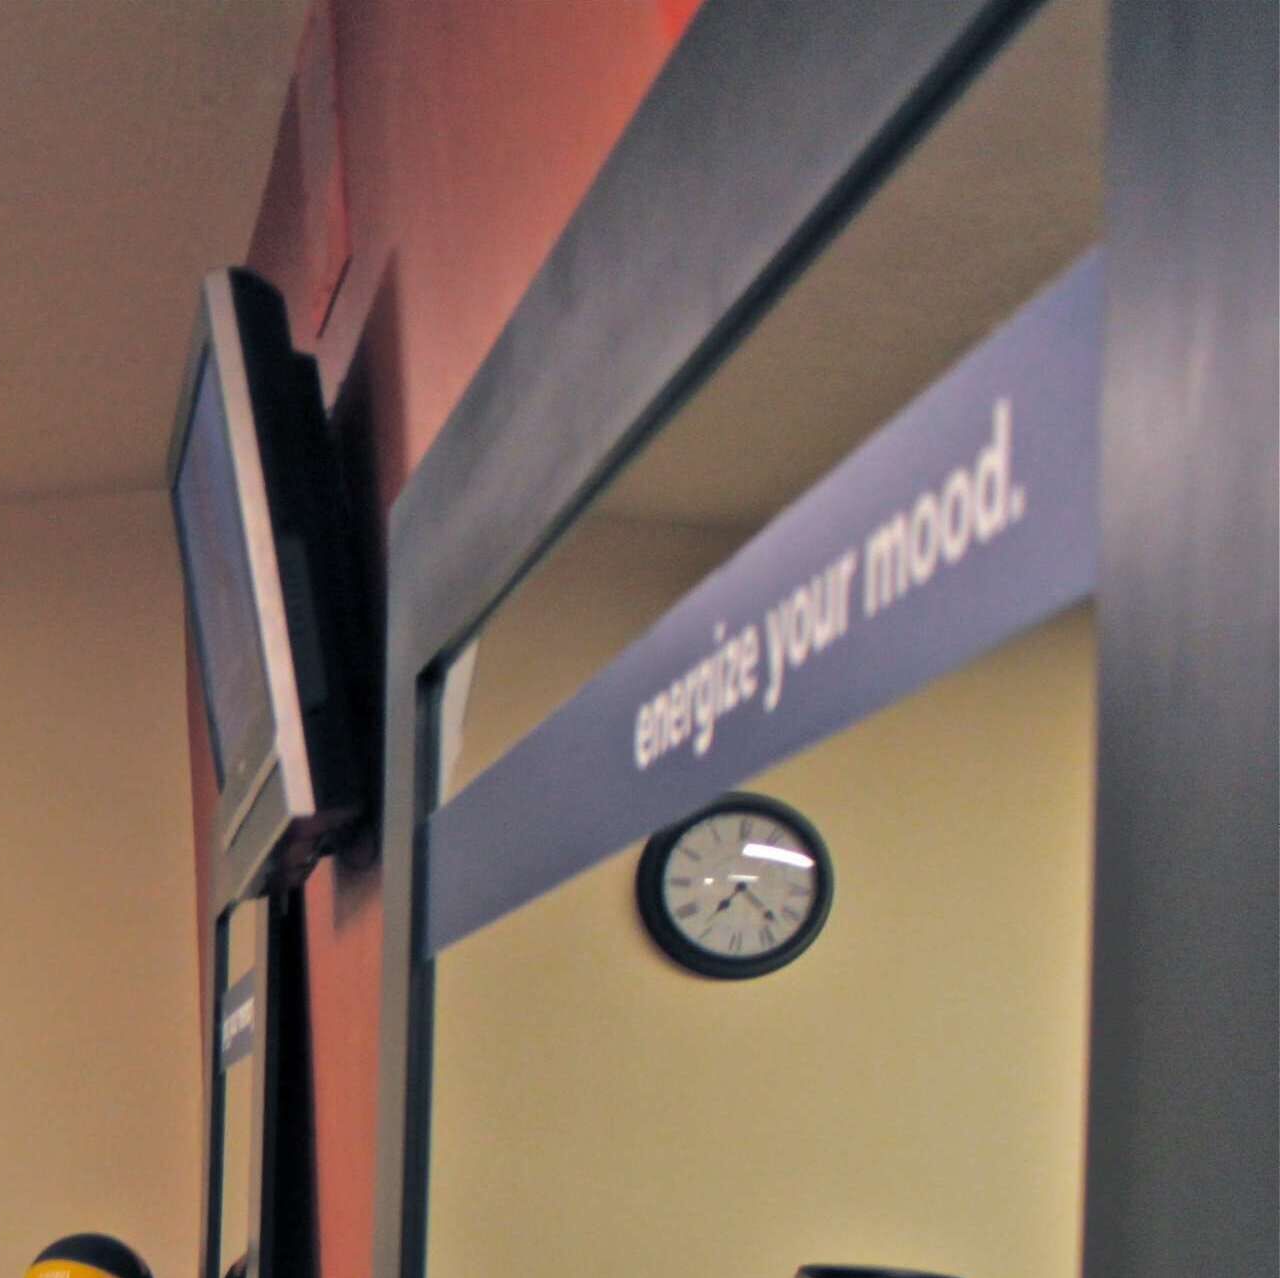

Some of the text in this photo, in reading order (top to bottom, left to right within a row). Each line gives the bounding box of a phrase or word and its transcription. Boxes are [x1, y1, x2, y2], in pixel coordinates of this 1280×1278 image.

[635, 397, 1027, 770] energize your mood.
